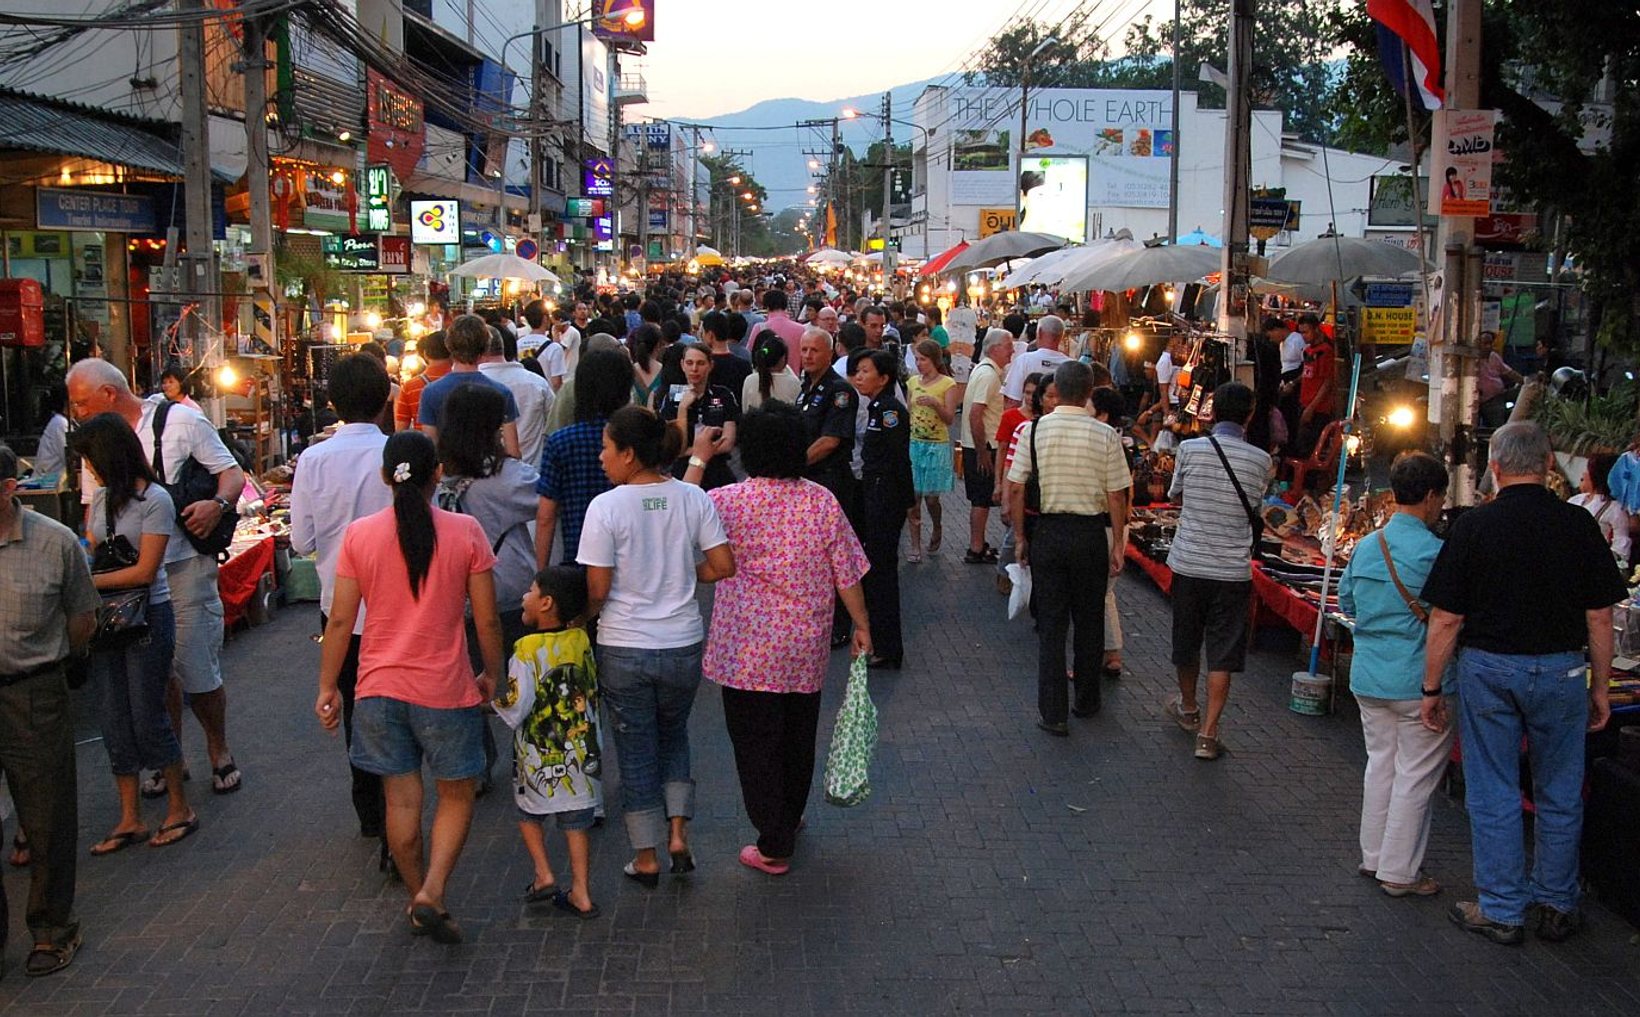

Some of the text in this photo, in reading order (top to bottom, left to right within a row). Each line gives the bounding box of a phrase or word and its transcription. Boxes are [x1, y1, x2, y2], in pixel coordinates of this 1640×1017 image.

[954, 98, 1173, 123] THE WHOLE EARTH
[368, 168, 388, 195] ยา
[58, 194, 90, 211] CENTER
[92, 198, 117, 213] PLACE
[368, 208, 389, 230] DRUG
[1386, 312, 1413, 321] HOUSE
[647, 500, 668, 511] LIFE
